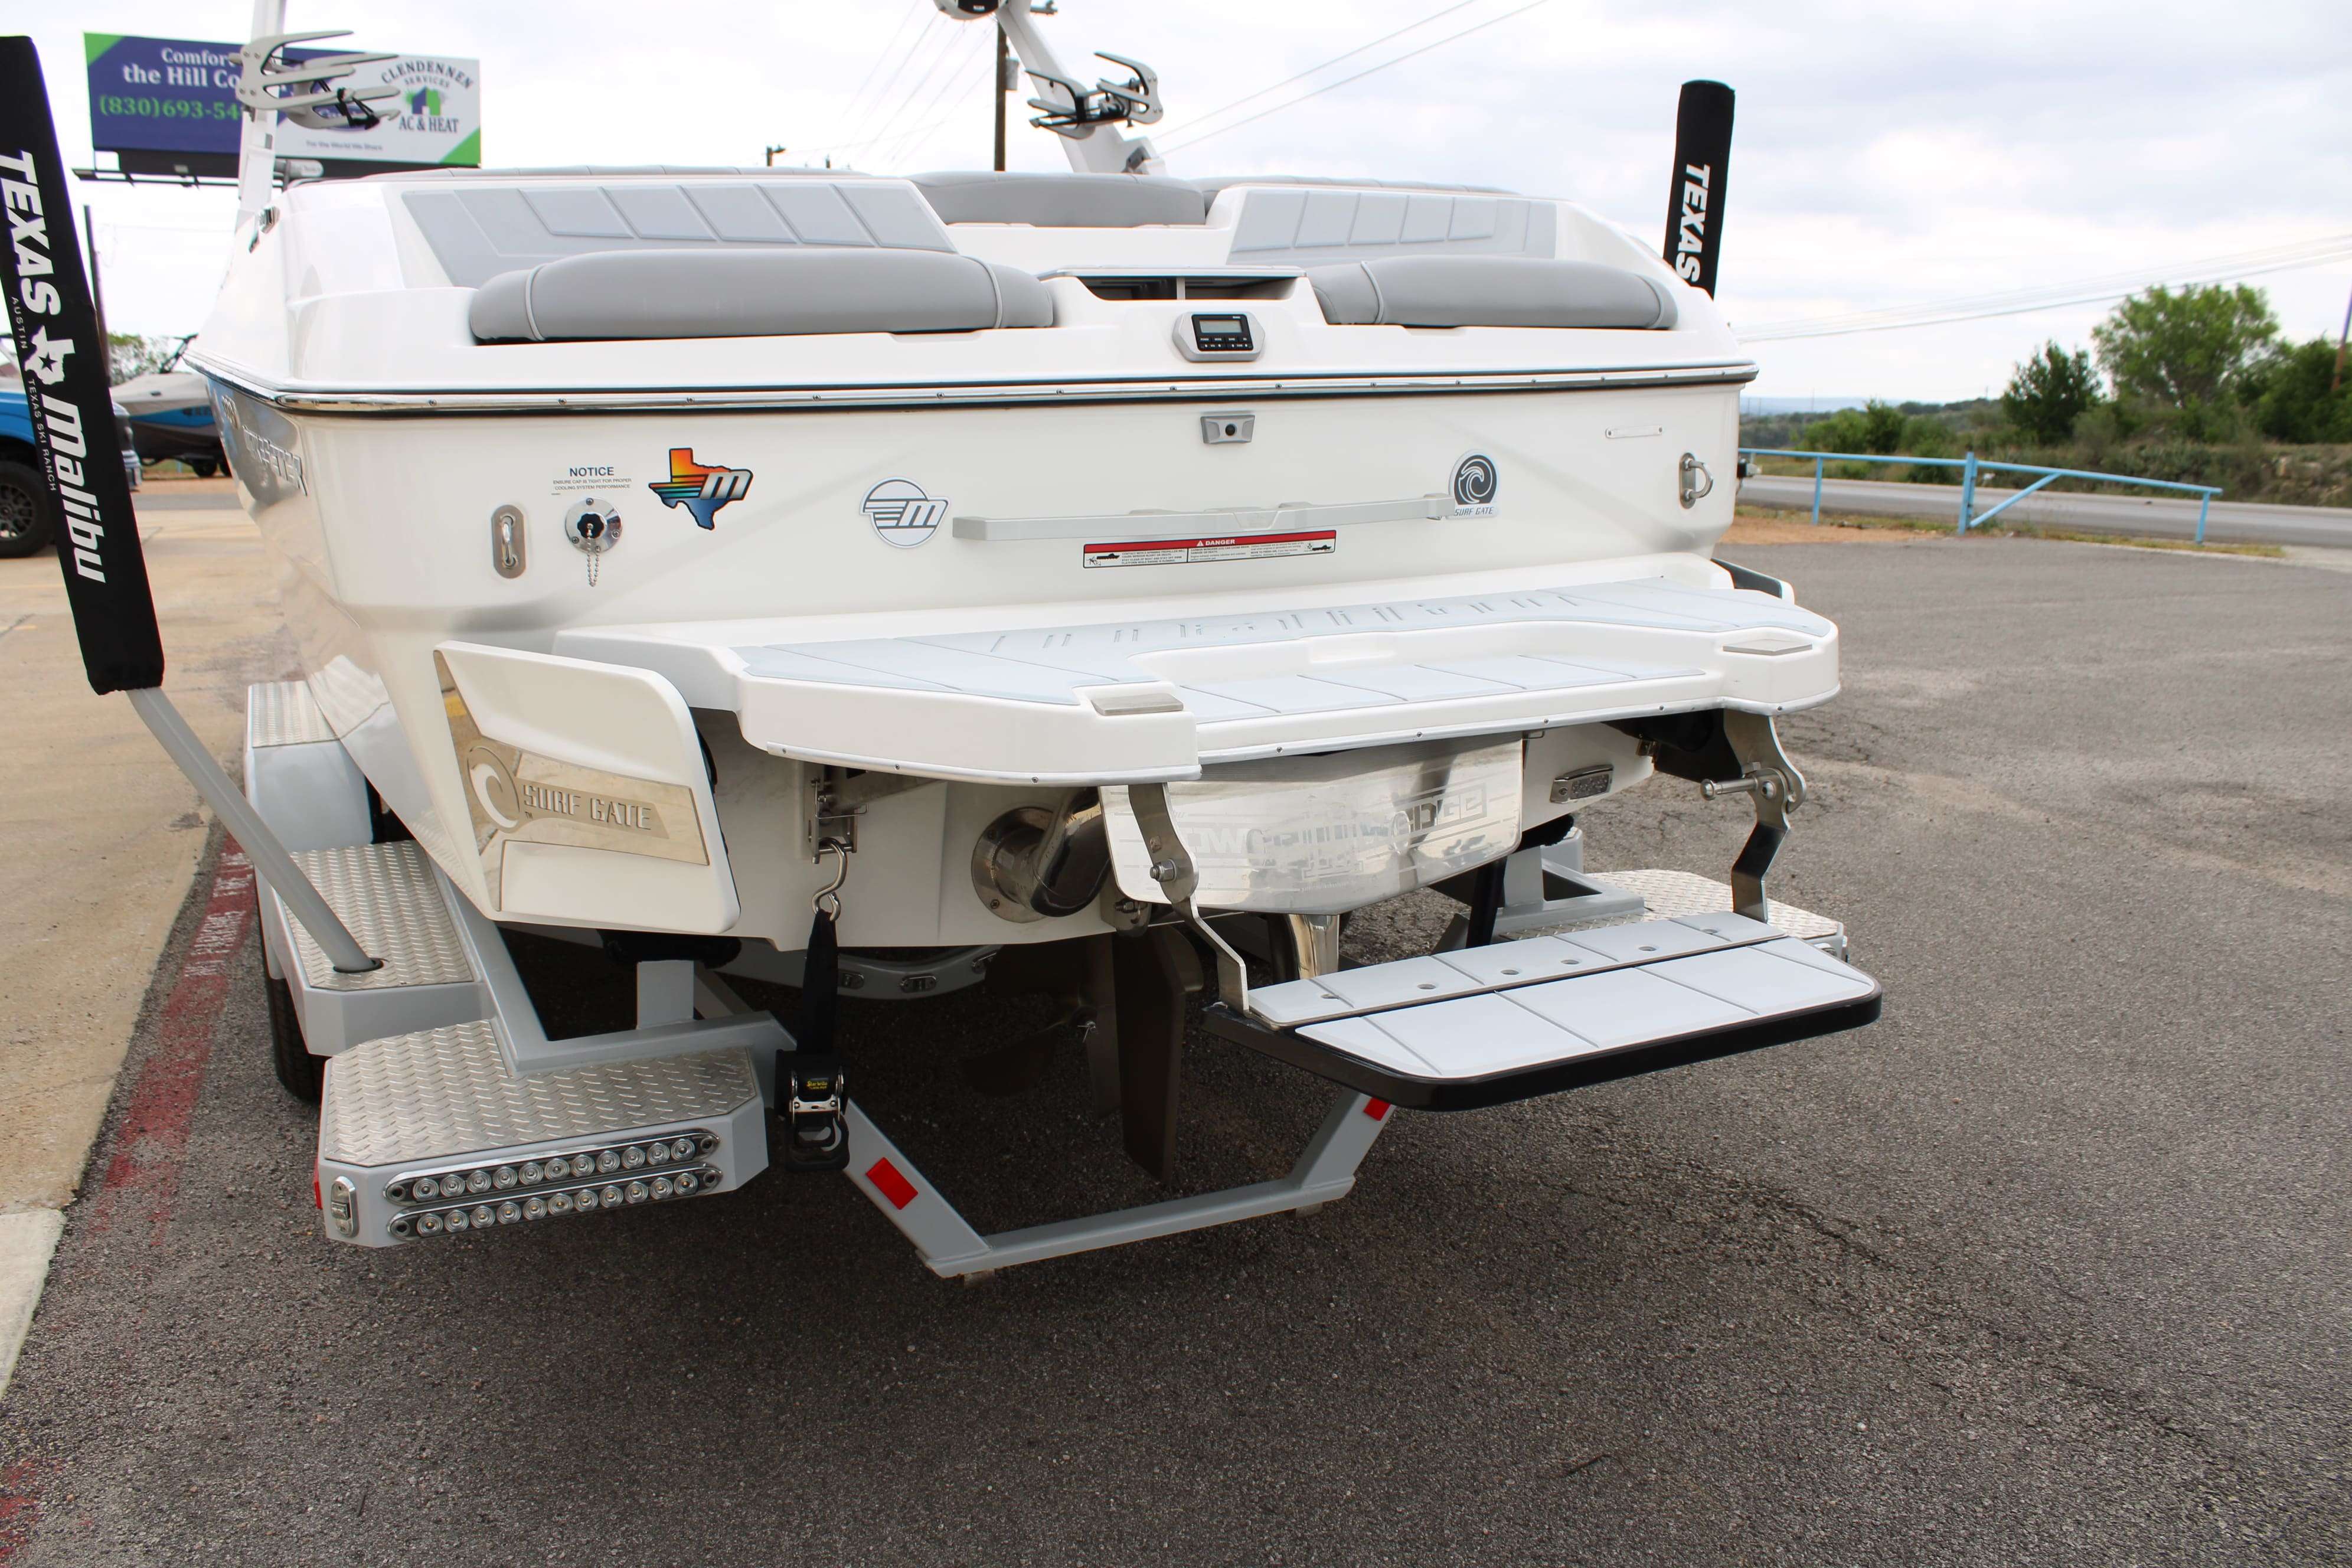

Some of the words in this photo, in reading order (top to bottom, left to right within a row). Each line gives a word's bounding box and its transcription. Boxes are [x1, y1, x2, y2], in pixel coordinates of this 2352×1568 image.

[161, 47, 236, 67] Comfor
[123, 63, 161, 84] the
[166, 66, 208, 87] Hill
[399, 116, 413, 130] AC
[417, 117, 426, 131] &
[429, 117, 459, 133] HEAT
[0, 150, 61, 315] TEXAS
[1676, 164, 1710, 282] TEXAS
[11, 297, 27, 349] AUSTIN
[28, 378, 41, 419] TEXAS
[37, 423, 46, 443] SKI
[43, 449, 57, 491] RANCH
[570, 467, 614, 476] NOTICE
[1454, 508, 1474, 516] SURF
[1475, 507, 1492, 515] GATE
[524, 784, 582, 816] SURF
[590, 797, 652, 831] GATE
